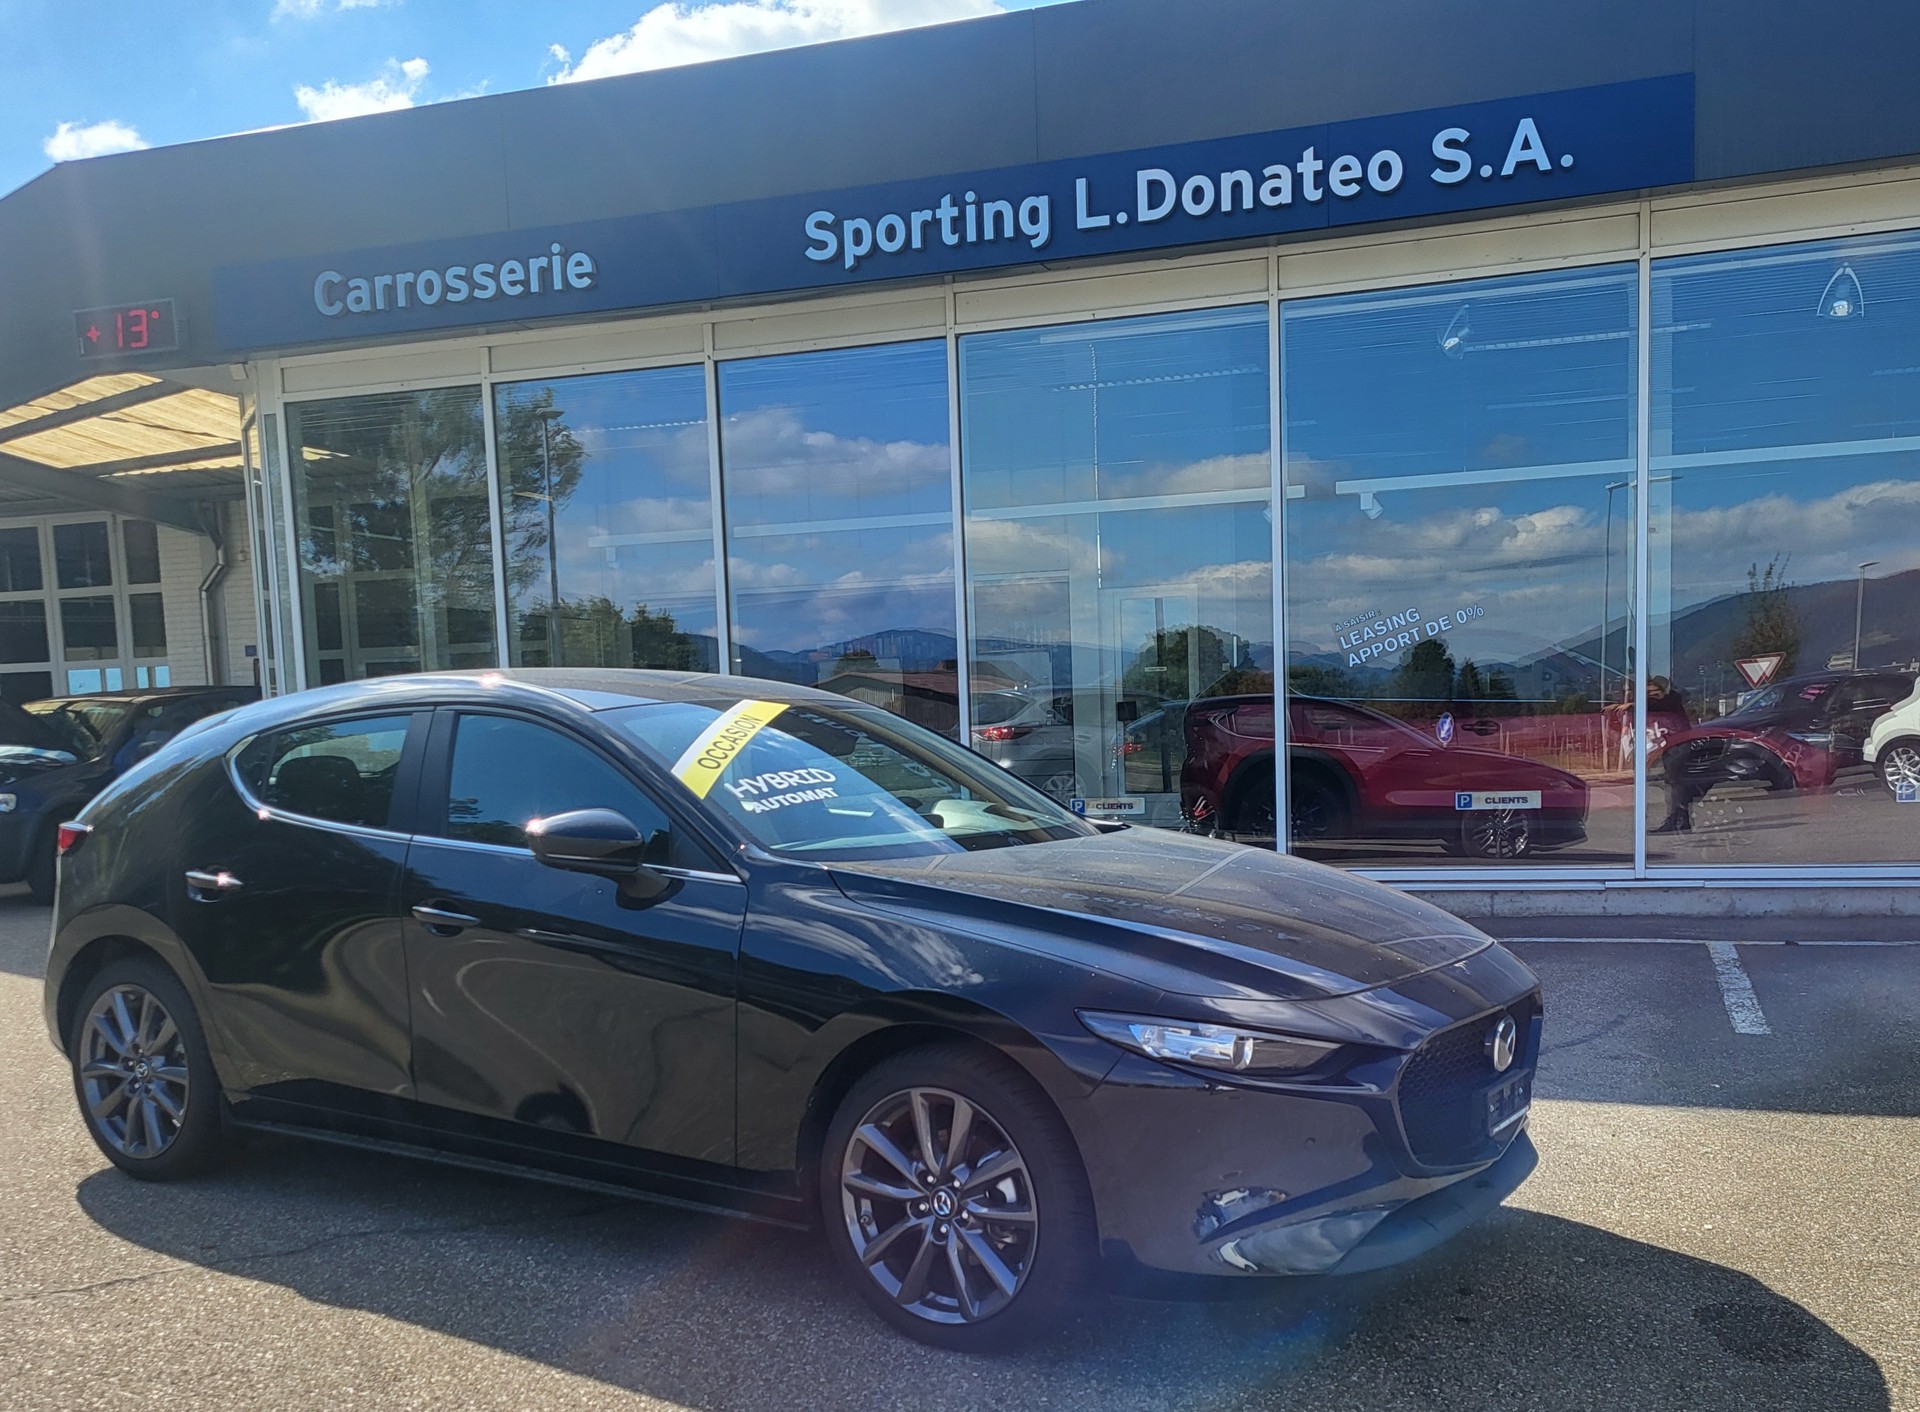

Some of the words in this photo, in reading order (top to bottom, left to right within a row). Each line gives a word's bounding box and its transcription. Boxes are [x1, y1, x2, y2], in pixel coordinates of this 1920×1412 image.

[804, 190, 1049, 270] Sporting
[1430, 117, 1574, 184] S.A.
[313, 242, 594, 316] Carrosserie
[1339, 608, 1421, 650] LEASING
[1343, 610, 1375, 628] SAISIR
[1348, 627, 1420, 668] APPORT
[1425, 615, 1453, 637] DE
[1456, 604, 1484, 624] 0%
[697, 714, 763, 770] OCCASION
[724, 768, 836, 798] HYBRID
[753, 787, 838, 814] AUTOMAT
[1461, 796, 1469, 807] P
[1484, 796, 1528, 805] CLIENTS
